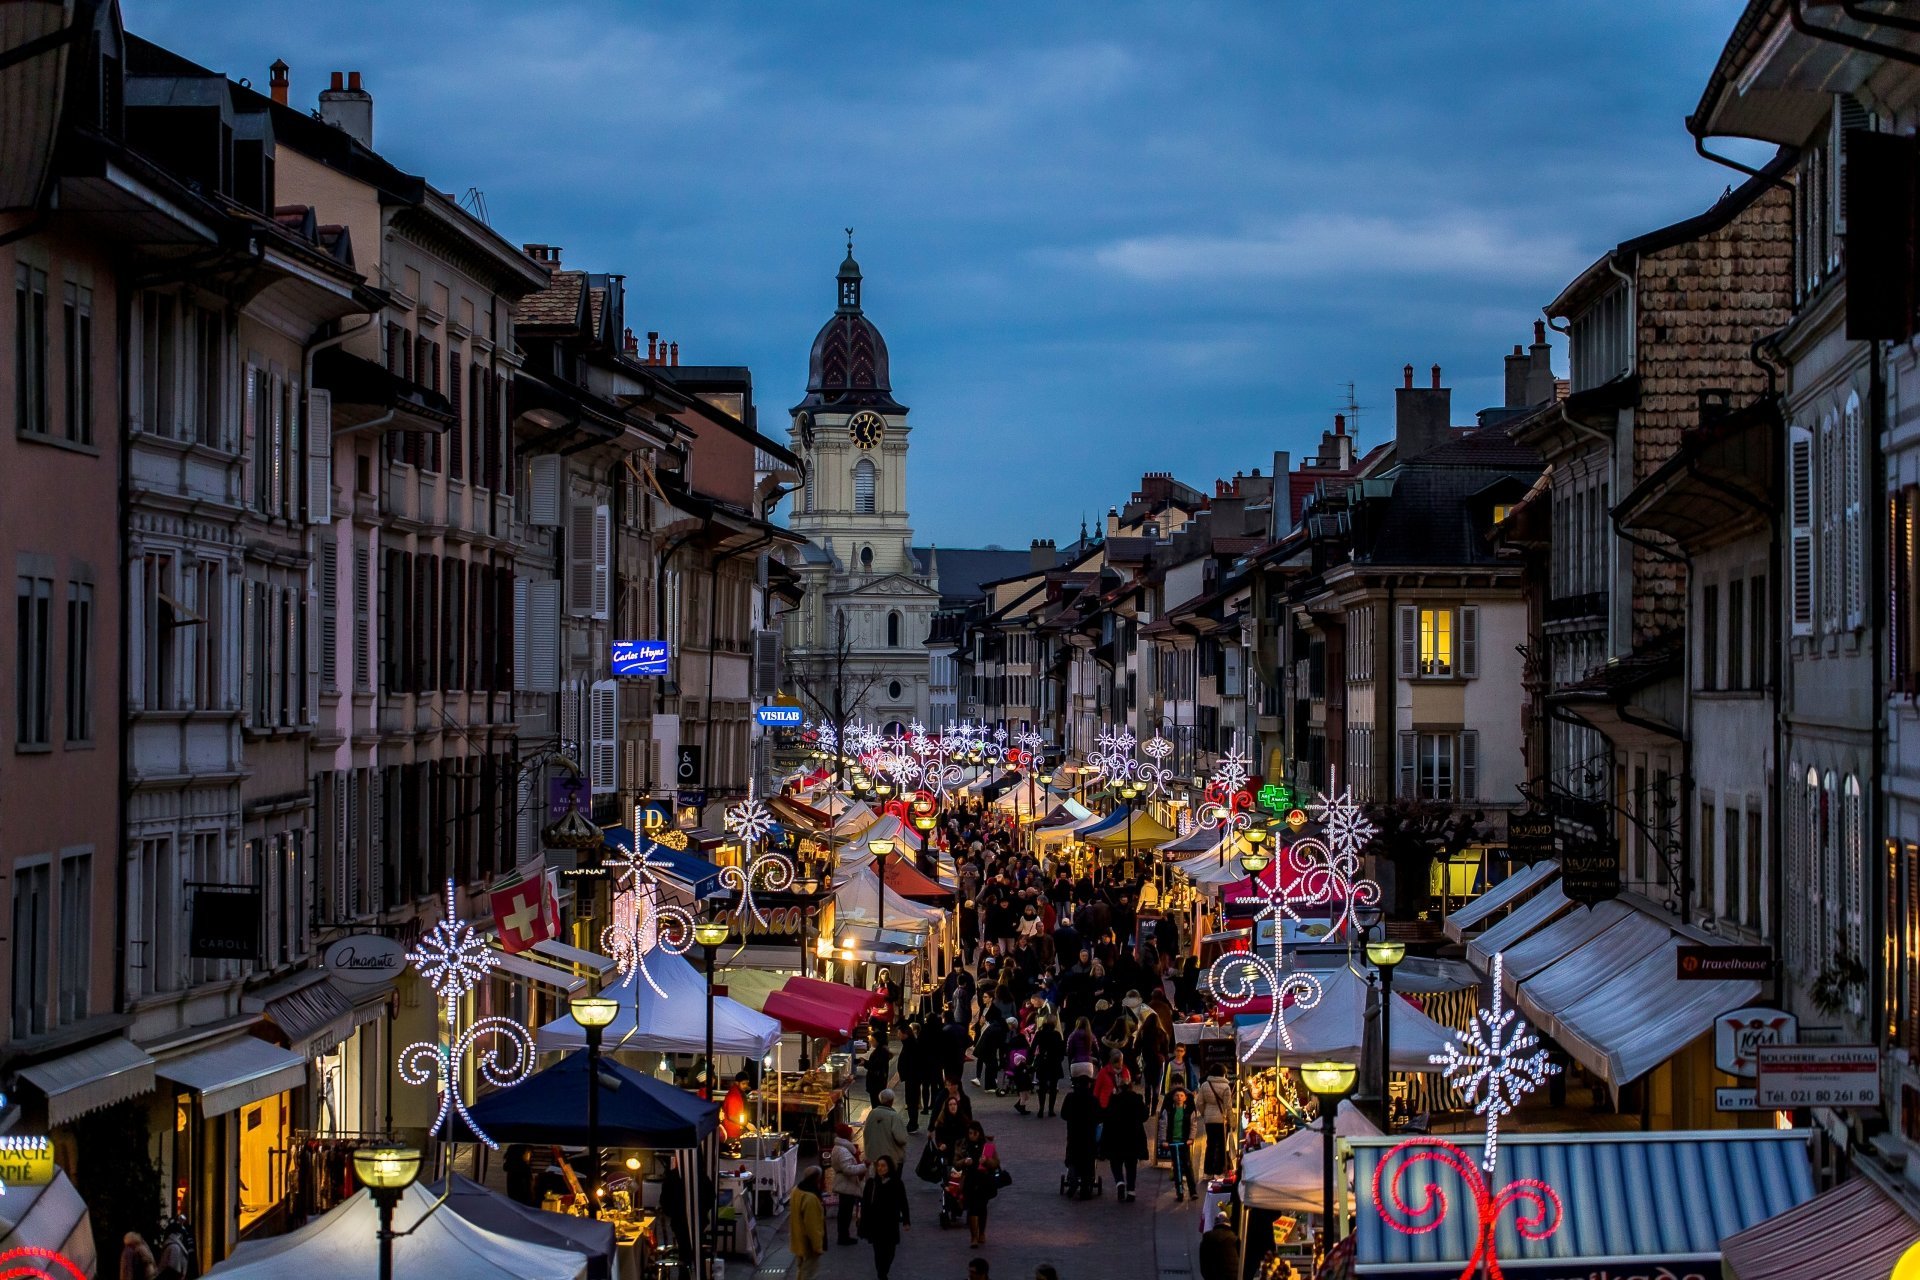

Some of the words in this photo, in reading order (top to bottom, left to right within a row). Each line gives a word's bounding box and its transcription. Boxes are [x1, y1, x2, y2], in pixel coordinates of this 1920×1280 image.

[759, 711, 800, 721] VISILAB
[199, 938, 249, 950] CAROLL
[1701, 959, 1767, 970] travelhouse
[1760, 1054, 1816, 1062] BOUCHERIE
[1791, 1090, 1811, 1102] 021
[1816, 1090, 1831, 1102] 80
[1834, 1090, 1854, 1102] 261
[1859, 1089, 1875, 1101] 80
